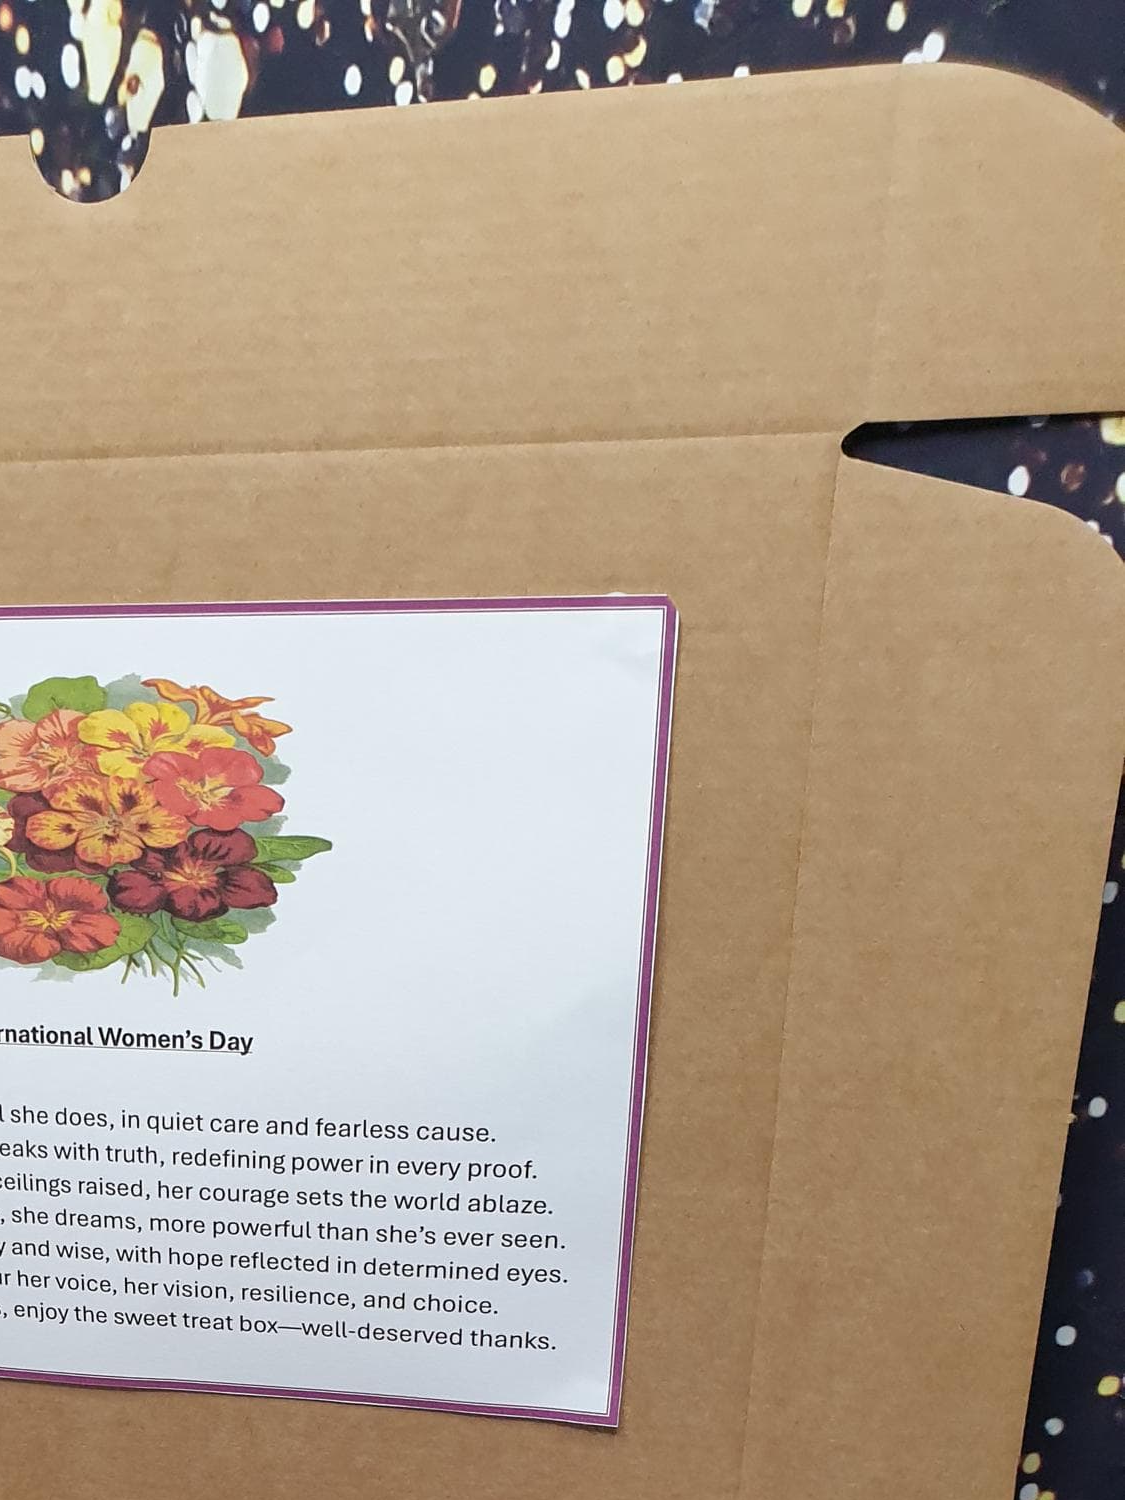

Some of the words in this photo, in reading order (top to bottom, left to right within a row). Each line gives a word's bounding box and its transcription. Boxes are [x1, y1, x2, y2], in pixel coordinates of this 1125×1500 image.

[97, 1026, 205, 1051] Women’s
[207, 1030, 255, 1057] Day
[10, 1104, 49, 1125] she
[54, 1106, 115, 1132] does,
[121, 1109, 140, 1130] in
[146, 1111, 204, 1135] quiet
[209, 1117, 260, 1135] care
[265, 1116, 309, 1137] and
[314, 1117, 410, 1140] fearless
[416, 1125, 496, 1143] cause.
[53, 1141, 100, 1162] with
[104, 1144, 165, 1168] truth,
[172, 1147, 287, 1175] redefining
[291, 1156, 364, 1176] power
[369, 1154, 390, 1175] in
[396, 1160, 462, 1182] every
[467, 1159, 538, 1182] proof.
[78, 1176, 151, 1201] raised,
[157, 1180, 194, 1201] her
[198, 1186, 290, 1209] courage
[295, 1189, 344, 1207] sets
[349, 1189, 387, 1209] the
[393, 1191, 460, 1212] world
[467, 1193, 554, 1215] ablaze.
[11, 1205, 49, 1225] she
[54, 1207, 143, 1234] dreams,
[149, 1217, 206, 1234] more
[212, 1219, 312, 1240] powerful
[316, 1221, 369, 1242] than
[443, 1231, 495, 1248] ever
[500, 1233, 566, 1250] seen.
[11, 1239, 50, 1258] and
[55, 1241, 110, 1264] wise,
[115, 1244, 162, 1265] with
[168, 1246, 224, 1271] hope
[229, 1251, 330, 1273] reflected
[337, 1255, 357, 1275] in
[363, 1257, 500, 1282] determined
[506, 1267, 568, 1287] eyes.
[16, 1269, 51, 1289] her
[54, 1273, 118, 1297] voice,
[124, 1276, 160, 1296] her
[162, 1279, 235, 1303] vision,
[241, 1284, 356, 1310] resilience,
[363, 1292, 406, 1311] and
[413, 1293, 499, 1315] choice.
[13, 1301, 70, 1325] enjoy
[73, 1304, 108, 1324] the
[113, 1311, 178, 1328] sweet
[181, 1312, 234, 1332] treat
[469, 1328, 557, 1351] thanks.
